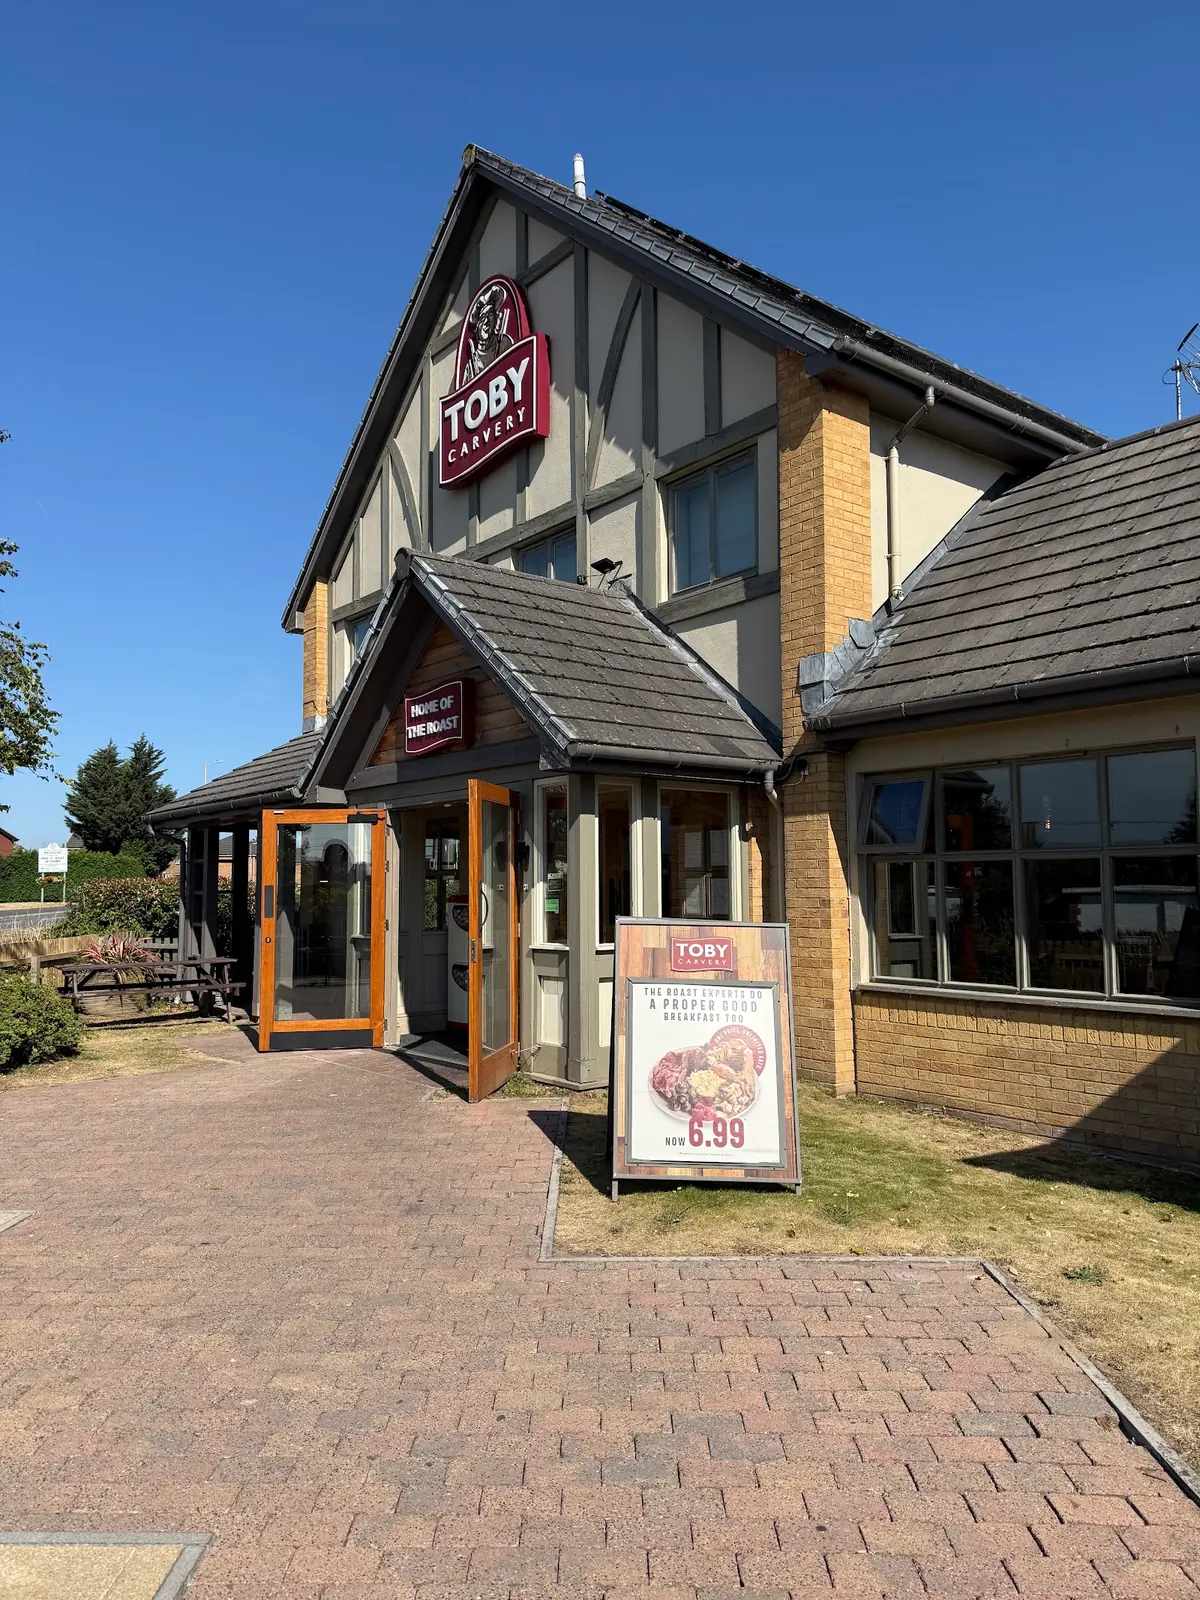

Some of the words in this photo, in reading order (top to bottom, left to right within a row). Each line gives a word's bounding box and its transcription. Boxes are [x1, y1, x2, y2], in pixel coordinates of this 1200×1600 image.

[444, 357, 530, 442] TOBY
[447, 406, 526, 463] CARVERY
[410, 700, 439, 718] HOME
[440, 695, 455, 710] OF
[406, 723, 426, 739] THE
[426, 715, 459, 735] ROAST
[675, 943, 729, 958] TOBY
[677, 958, 727, 966] CARVERY
[644, 987, 662, 996] THE
[666, 987, 698, 997] ROAST
[702, 988, 745, 999] EXPERTS
[750, 990, 762, 999] DO
[649, 998, 656, 1010] A
[663, 998, 715, 1011] PROPER
[722, 1000, 758, 1013] GOOD
[663, 1012, 721, 1022] BREAKFAST
[725, 1014, 744, 1023] TOO
[665, 1136, 686, 1146] NOW
